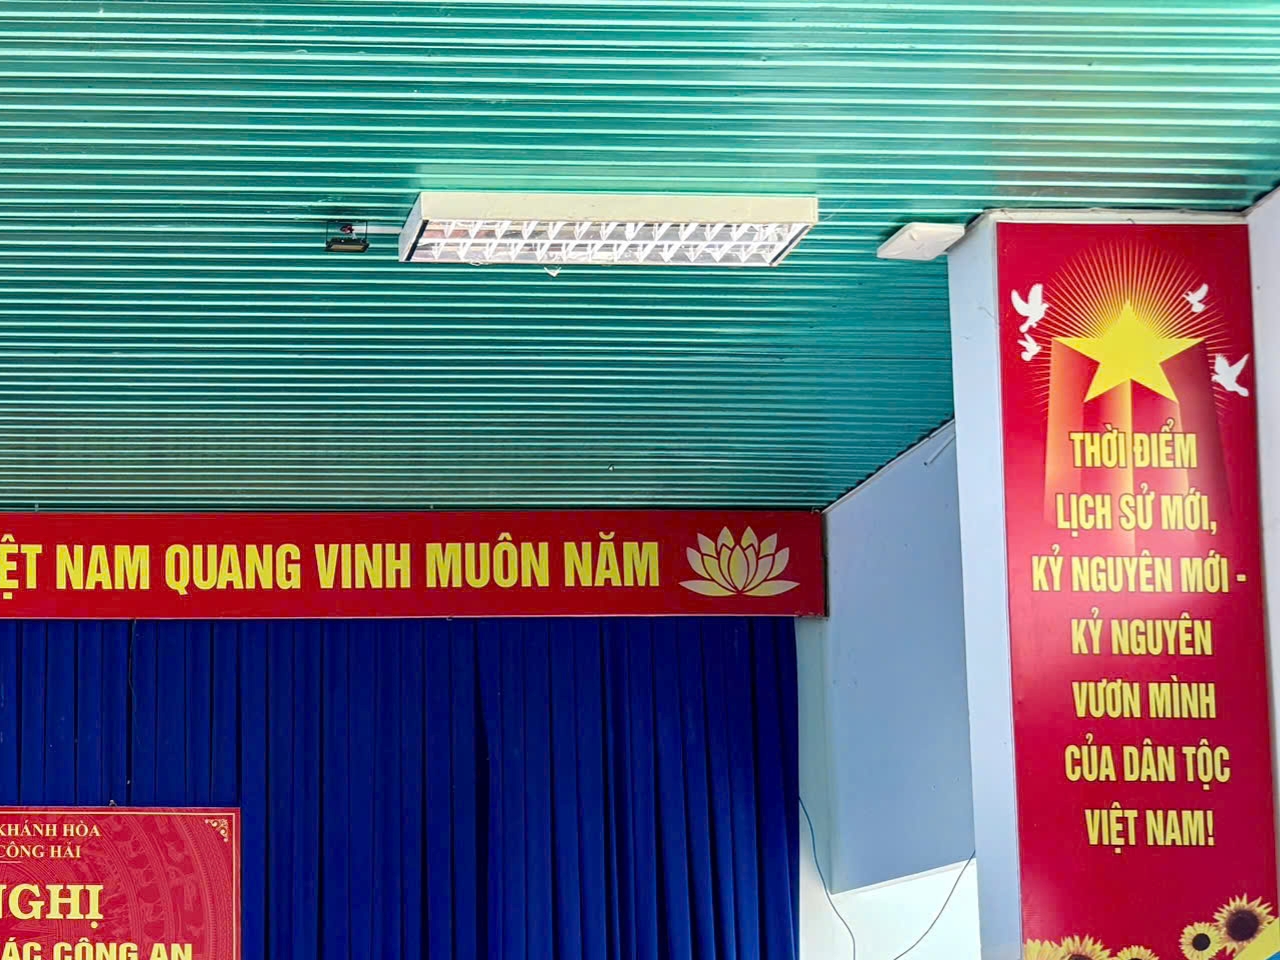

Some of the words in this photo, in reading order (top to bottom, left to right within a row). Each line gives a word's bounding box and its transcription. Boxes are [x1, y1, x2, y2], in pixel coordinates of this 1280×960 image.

[1069, 423, 1127, 468] THỜI
[1133, 418, 1197, 469] ĐIỂM
[1055, 493, 1112, 537] LỊCH
[1119, 482, 1155, 530] SỬ
[1160, 487, 1217, 535] MỚI,
[56, 544, 150, 591] NAM
[165, 543, 301, 595] QUANG
[314, 543, 411, 589] VINH
[425, 532, 549, 588] MUÔN
[564, 531, 659, 587] NĂM
[1031, 544, 1064, 591] KỶ
[1072, 549, 1173, 593] NGUYÊN
[1179, 550, 1229, 593] MỚI
[1071, 607, 1103, 655] KỶ
[1110, 612, 1213, 656] NGUYÊN
[1072, 678, 1141, 718] VƯƠN
[1149, 674, 1216, 719] MÌNH
[1065, 733, 1117, 782] CỦA
[1123, 738, 1176, 782] DÂN
[1182, 738, 1231, 790] TỘC
[49, 841, 81, 859] HẢI
[62, 821, 101, 837] HÒA
[1085, 801, 1138, 854] VIỆT
[1145, 810, 1215, 846] NAM!
